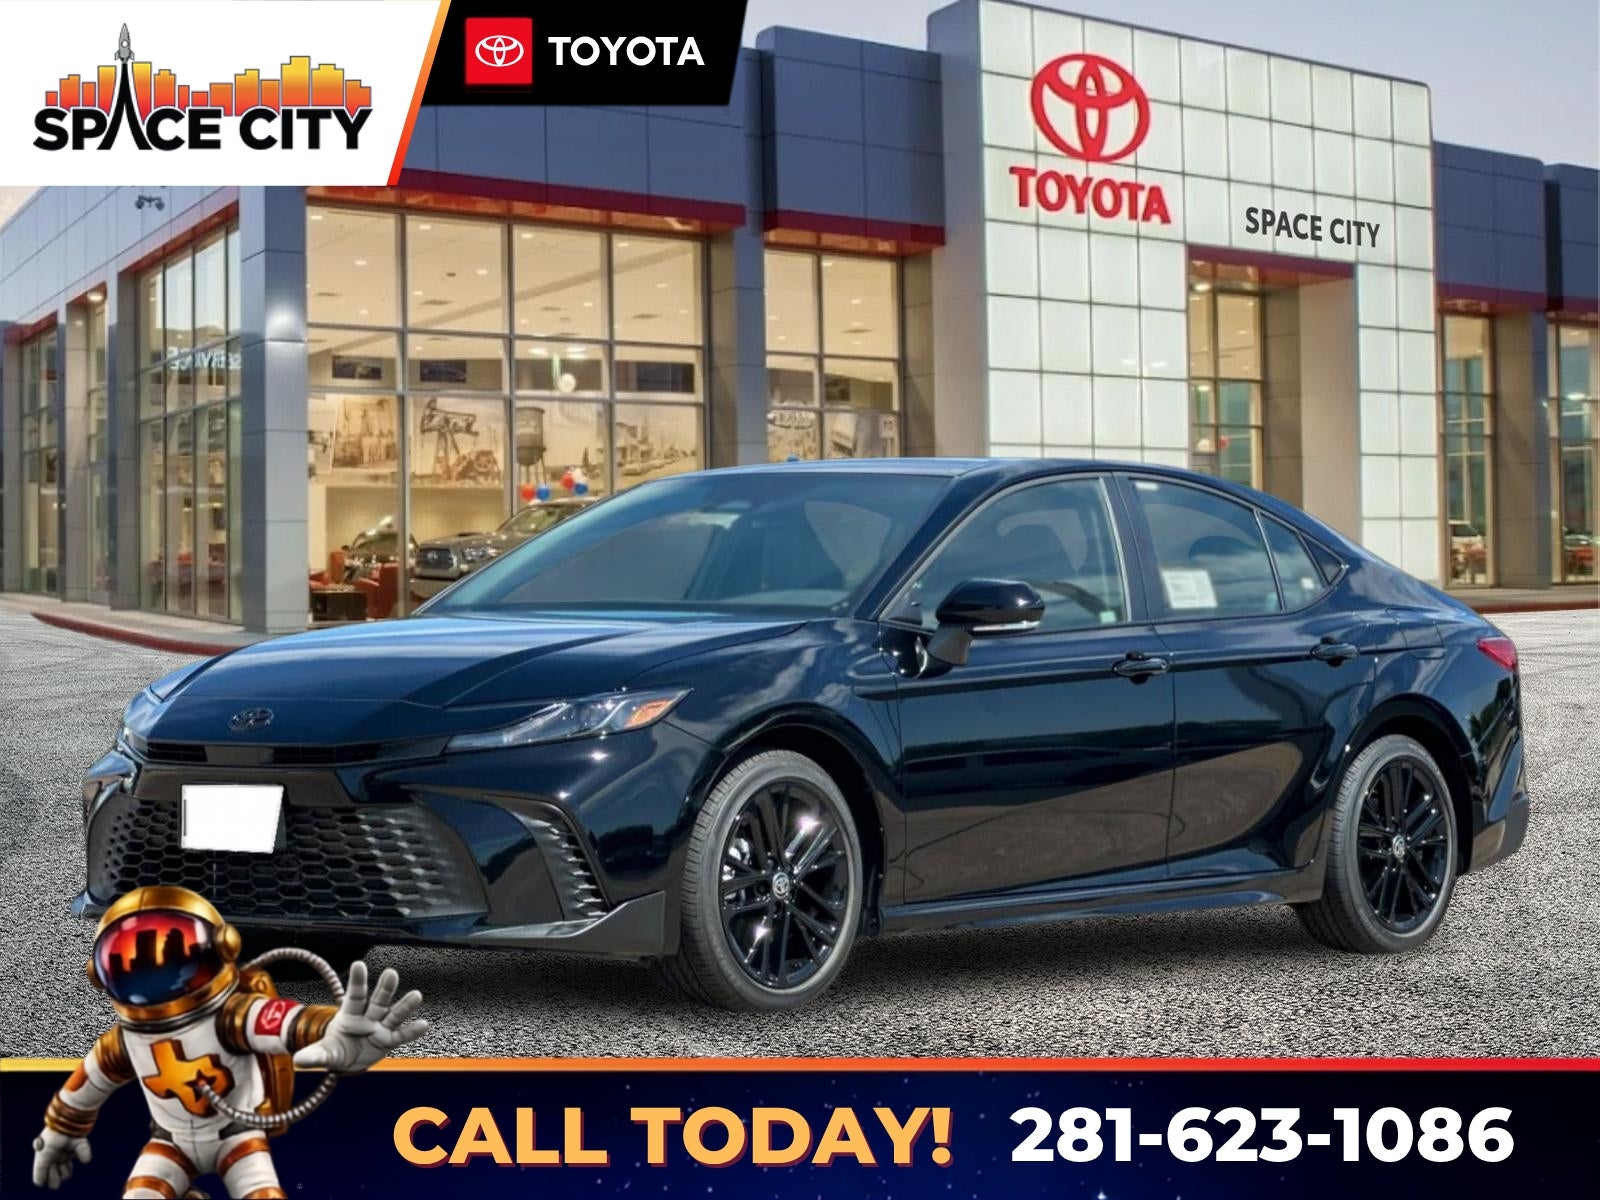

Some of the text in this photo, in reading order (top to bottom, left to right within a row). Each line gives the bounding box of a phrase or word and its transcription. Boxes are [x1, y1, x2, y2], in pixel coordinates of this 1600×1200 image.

[1009, 166, 1172, 224] TOYOTA
[1245, 206, 1381, 249] SPACE CITY
